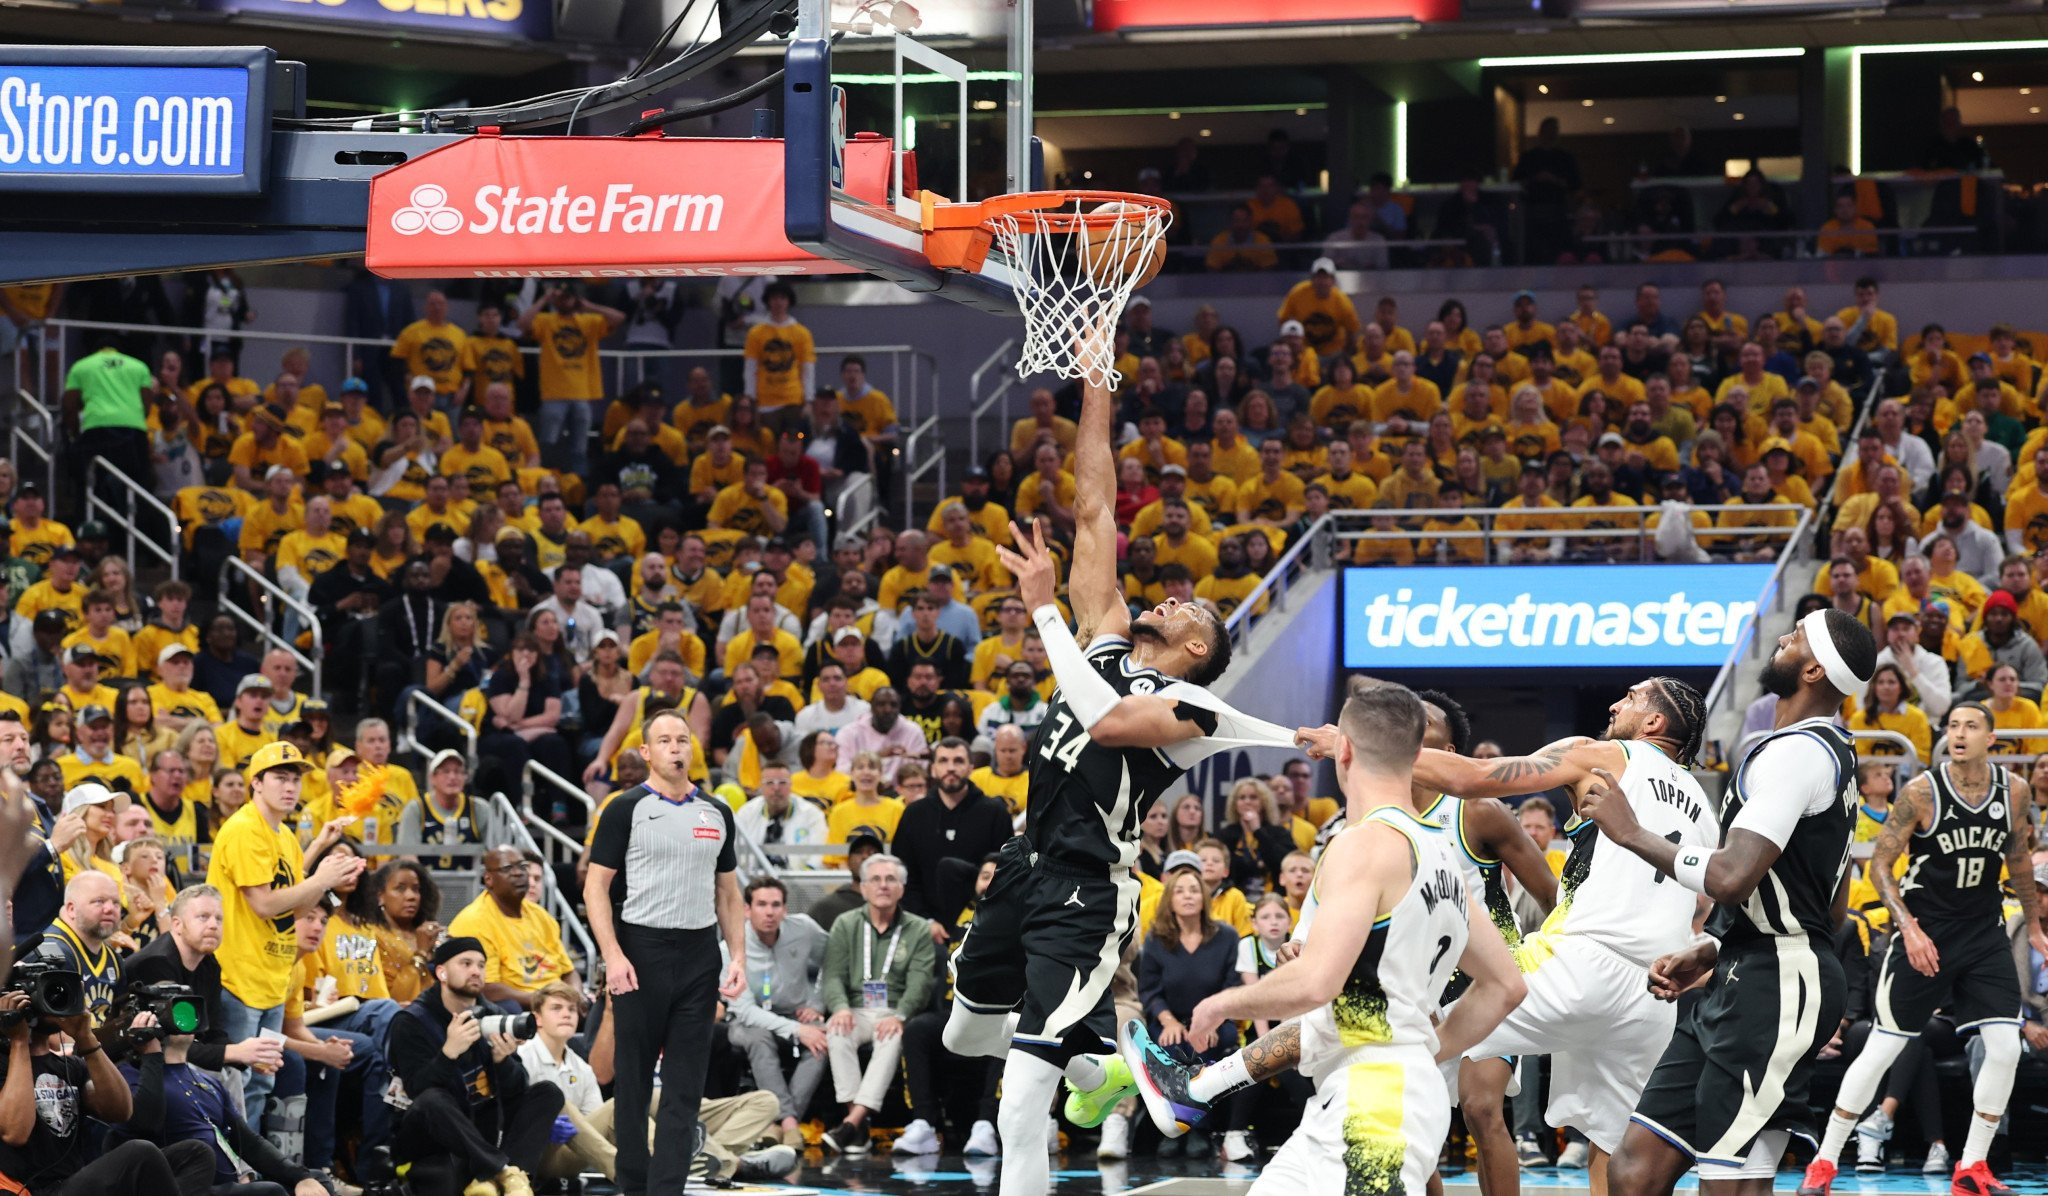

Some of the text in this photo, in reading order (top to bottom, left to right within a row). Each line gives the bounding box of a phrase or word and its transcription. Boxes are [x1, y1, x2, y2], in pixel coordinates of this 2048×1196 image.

[0, 77, 233, 166] Store.com
[1365, 587, 1756, 647] ticketmaster
[1040, 711, 1091, 773] 34
[1648, 778, 1701, 823] TOPPIN
[1936, 826, 2007, 854] BUCKS
[1956, 857, 1985, 889] 18
